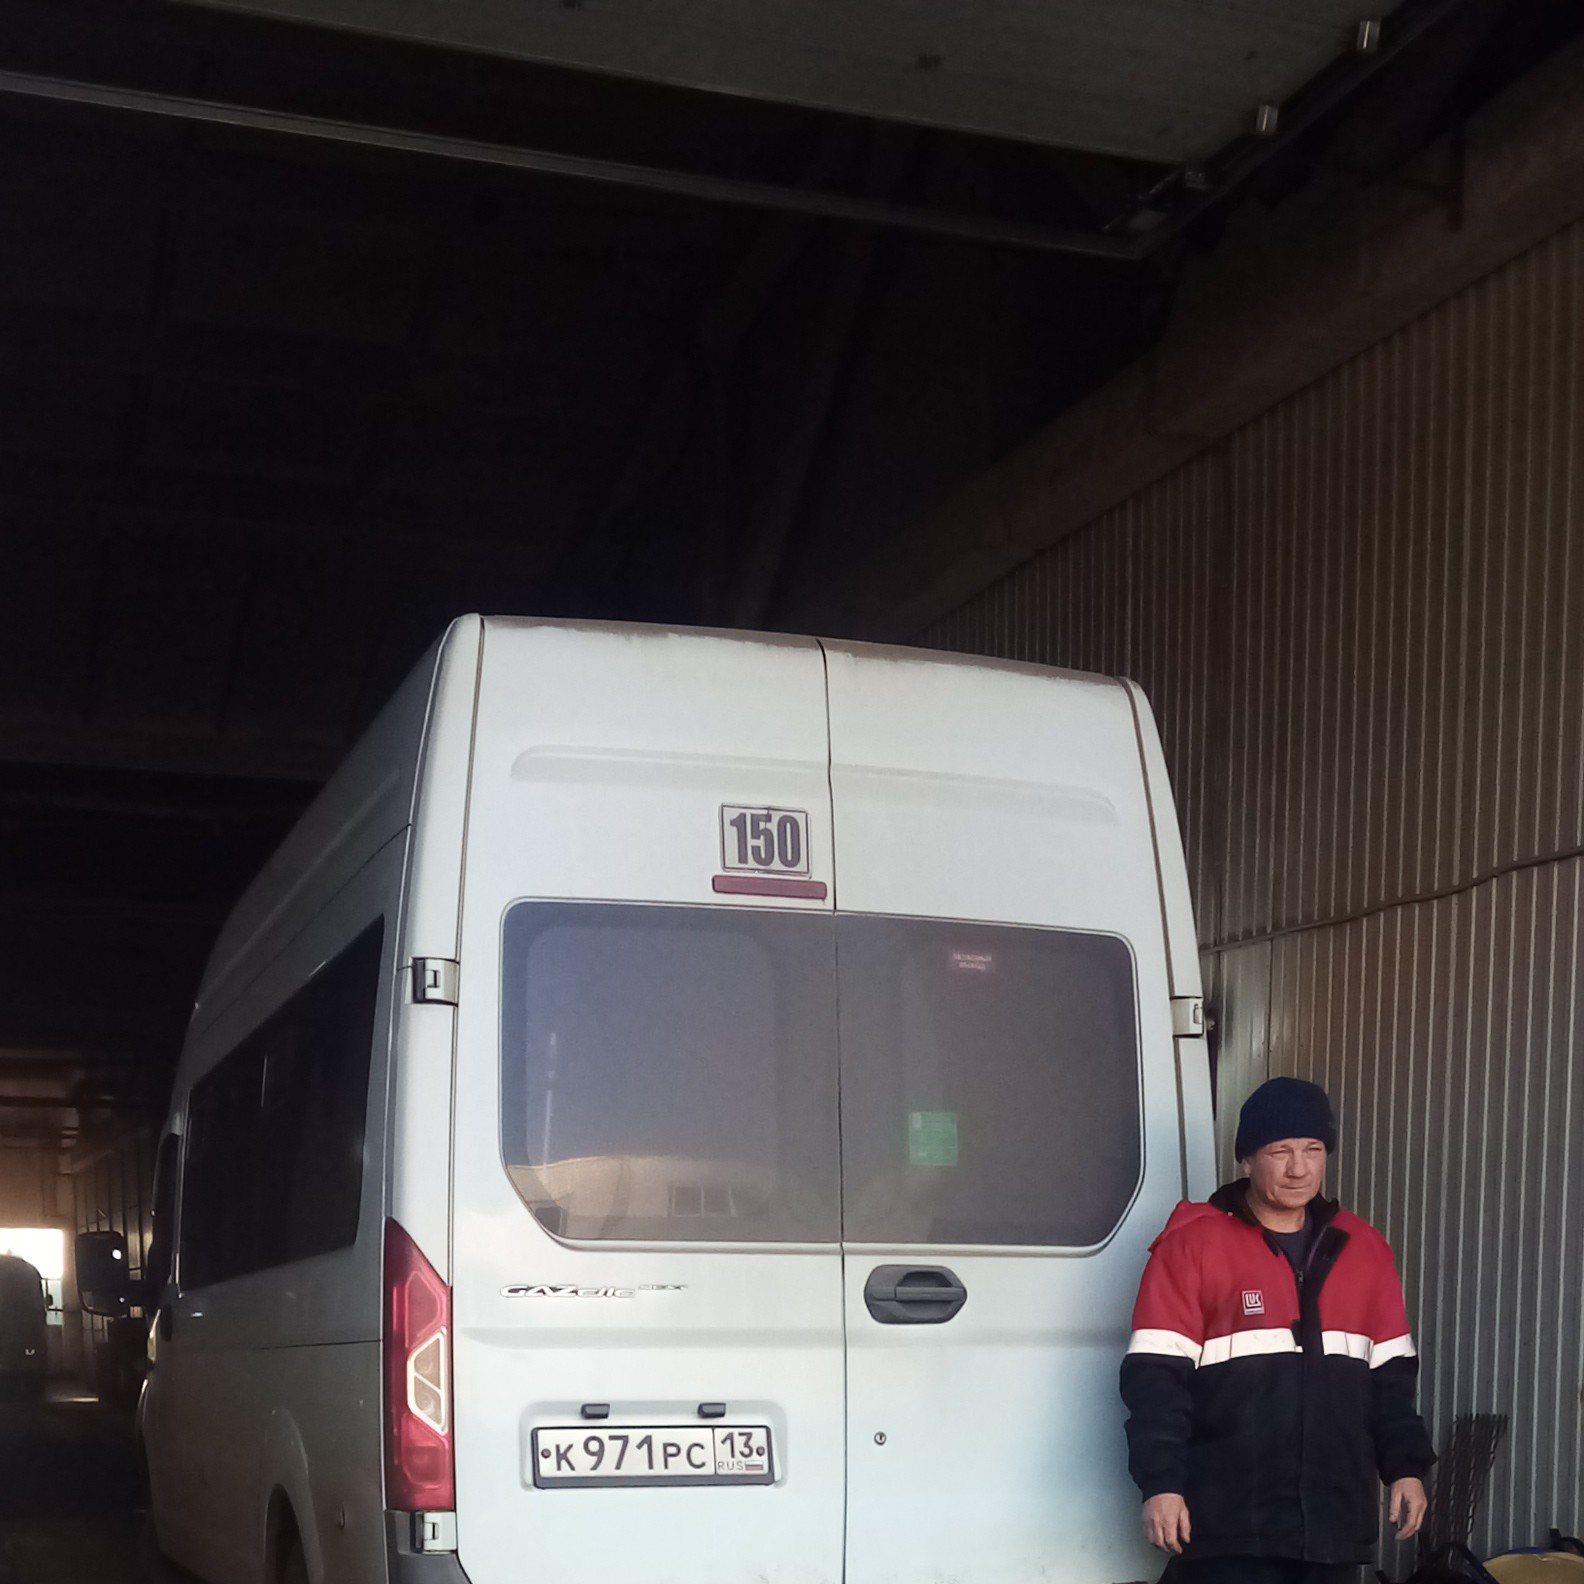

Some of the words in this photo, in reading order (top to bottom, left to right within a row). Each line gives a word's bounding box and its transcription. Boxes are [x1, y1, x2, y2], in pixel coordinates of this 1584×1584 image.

[729, 812, 801, 868] 150
[720, 1432, 754, 1459] 13
[717, 1460, 744, 1472] RUS
